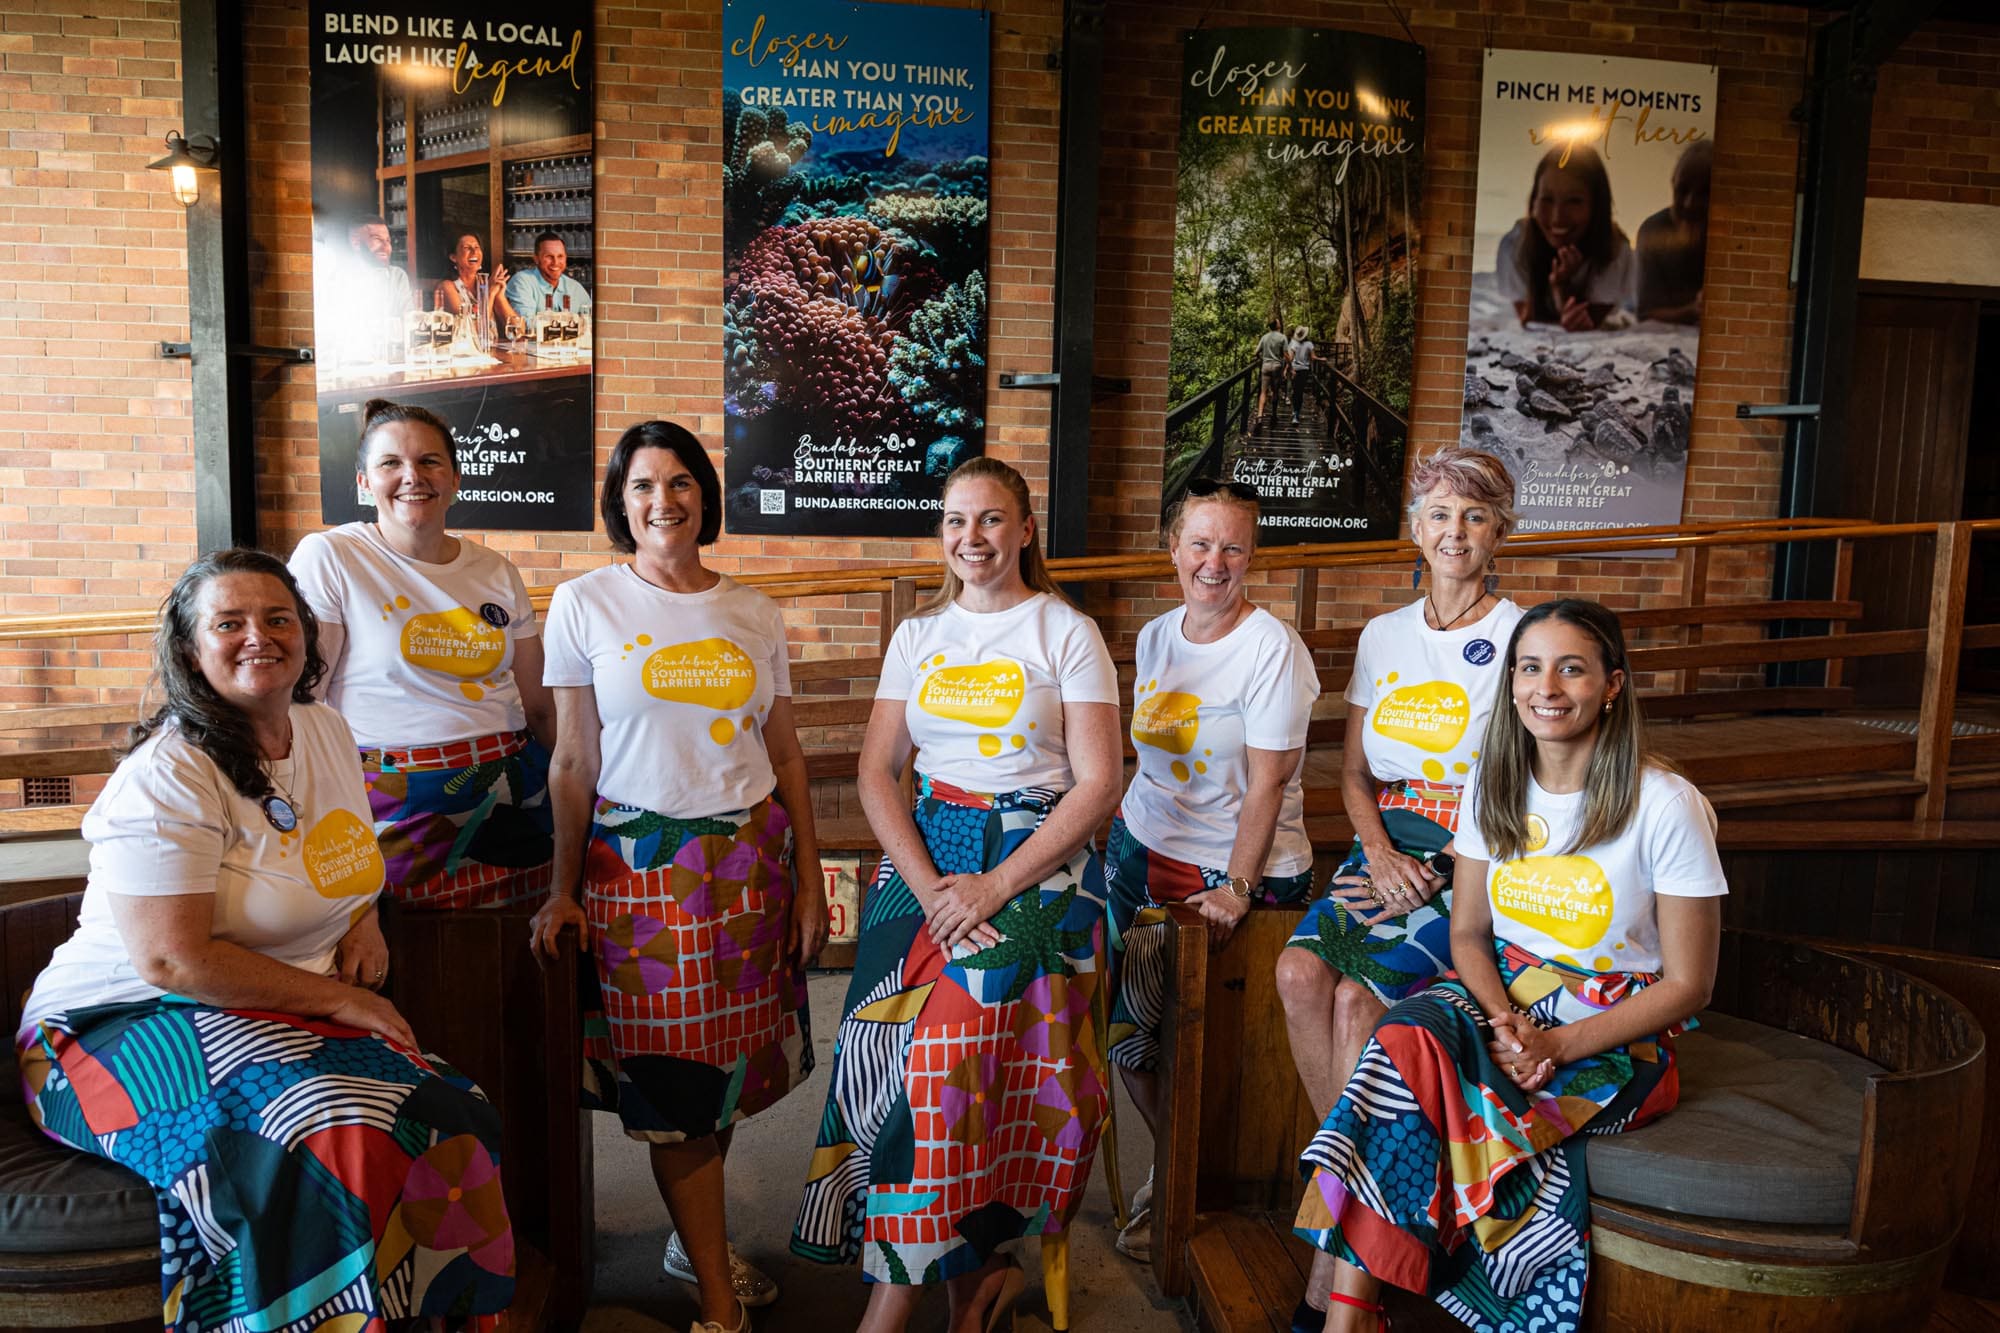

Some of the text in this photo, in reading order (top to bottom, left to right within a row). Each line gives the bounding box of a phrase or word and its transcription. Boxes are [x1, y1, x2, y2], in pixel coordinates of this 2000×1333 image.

[325, 13, 562, 47] BLEND LIKE A LOCAL
[731, 14, 848, 68] closer
[325, 43, 479, 70] LAUGH LIKE A
[452, 30, 582, 107] legend
[779, 58, 974, 91] THAN YOU THINK,
[1191, 45, 1307, 97] closer
[740, 86, 959, 115] GREATER THAN YOU
[1237, 87, 1296, 107] THAN
[1304, 89, 1350, 110] YOU
[1496, 80, 1701, 113] PINCH ME MOMENTS
[812, 105, 974, 157] imagine
[1198, 116, 1402, 145] GREATER THAN YOU
[1635, 105, 1706, 146] here
[1267, 138, 1414, 185] imagine
[478, 451, 526, 464] GREAT
[794, 434, 885, 463] Bundaberg
[461, 463, 495, 476] REEF
[795, 459, 922, 472] SOUTHERN GREAT
[1521, 461, 1600, 488] Bundaberg
[795, 471, 891, 484] BARRIER REEF
[1233, 475, 1340, 488] SOUTHERN GREAT
[456, 490, 555, 503] RGREGION.ORG
[1256, 486, 1314, 498] RIER REEF
[1520, 495, 1606, 508] BARRIER REEF
[1521, 484, 1632, 497] SOUTHERN GREAT
[1257, 516, 1368, 529] ABERGREGION.ORG
[409, 636, 503, 651] SOUTHERN GREAT
[409, 646, 482, 659] BARRIER REEF
[651, 669, 753, 678] SOUTHERN GREAT
[652, 678, 731, 689] BARRIER REEF
[925, 695, 996, 707] BARRIER REEF
[927, 687, 1020, 698] SOUTHERN GREAT
[1377, 716, 1441, 732] BARRIER REEF
[1380, 707, 1464, 726] SOUTHERN GREAT
[314, 852, 357, 875] SOUTHERN
[320, 857, 371, 888] BARRIER REEF
[1498, 886, 1608, 917] SOUTHERN GREAT
[1498, 896, 1579, 922] BARRIER REEF
